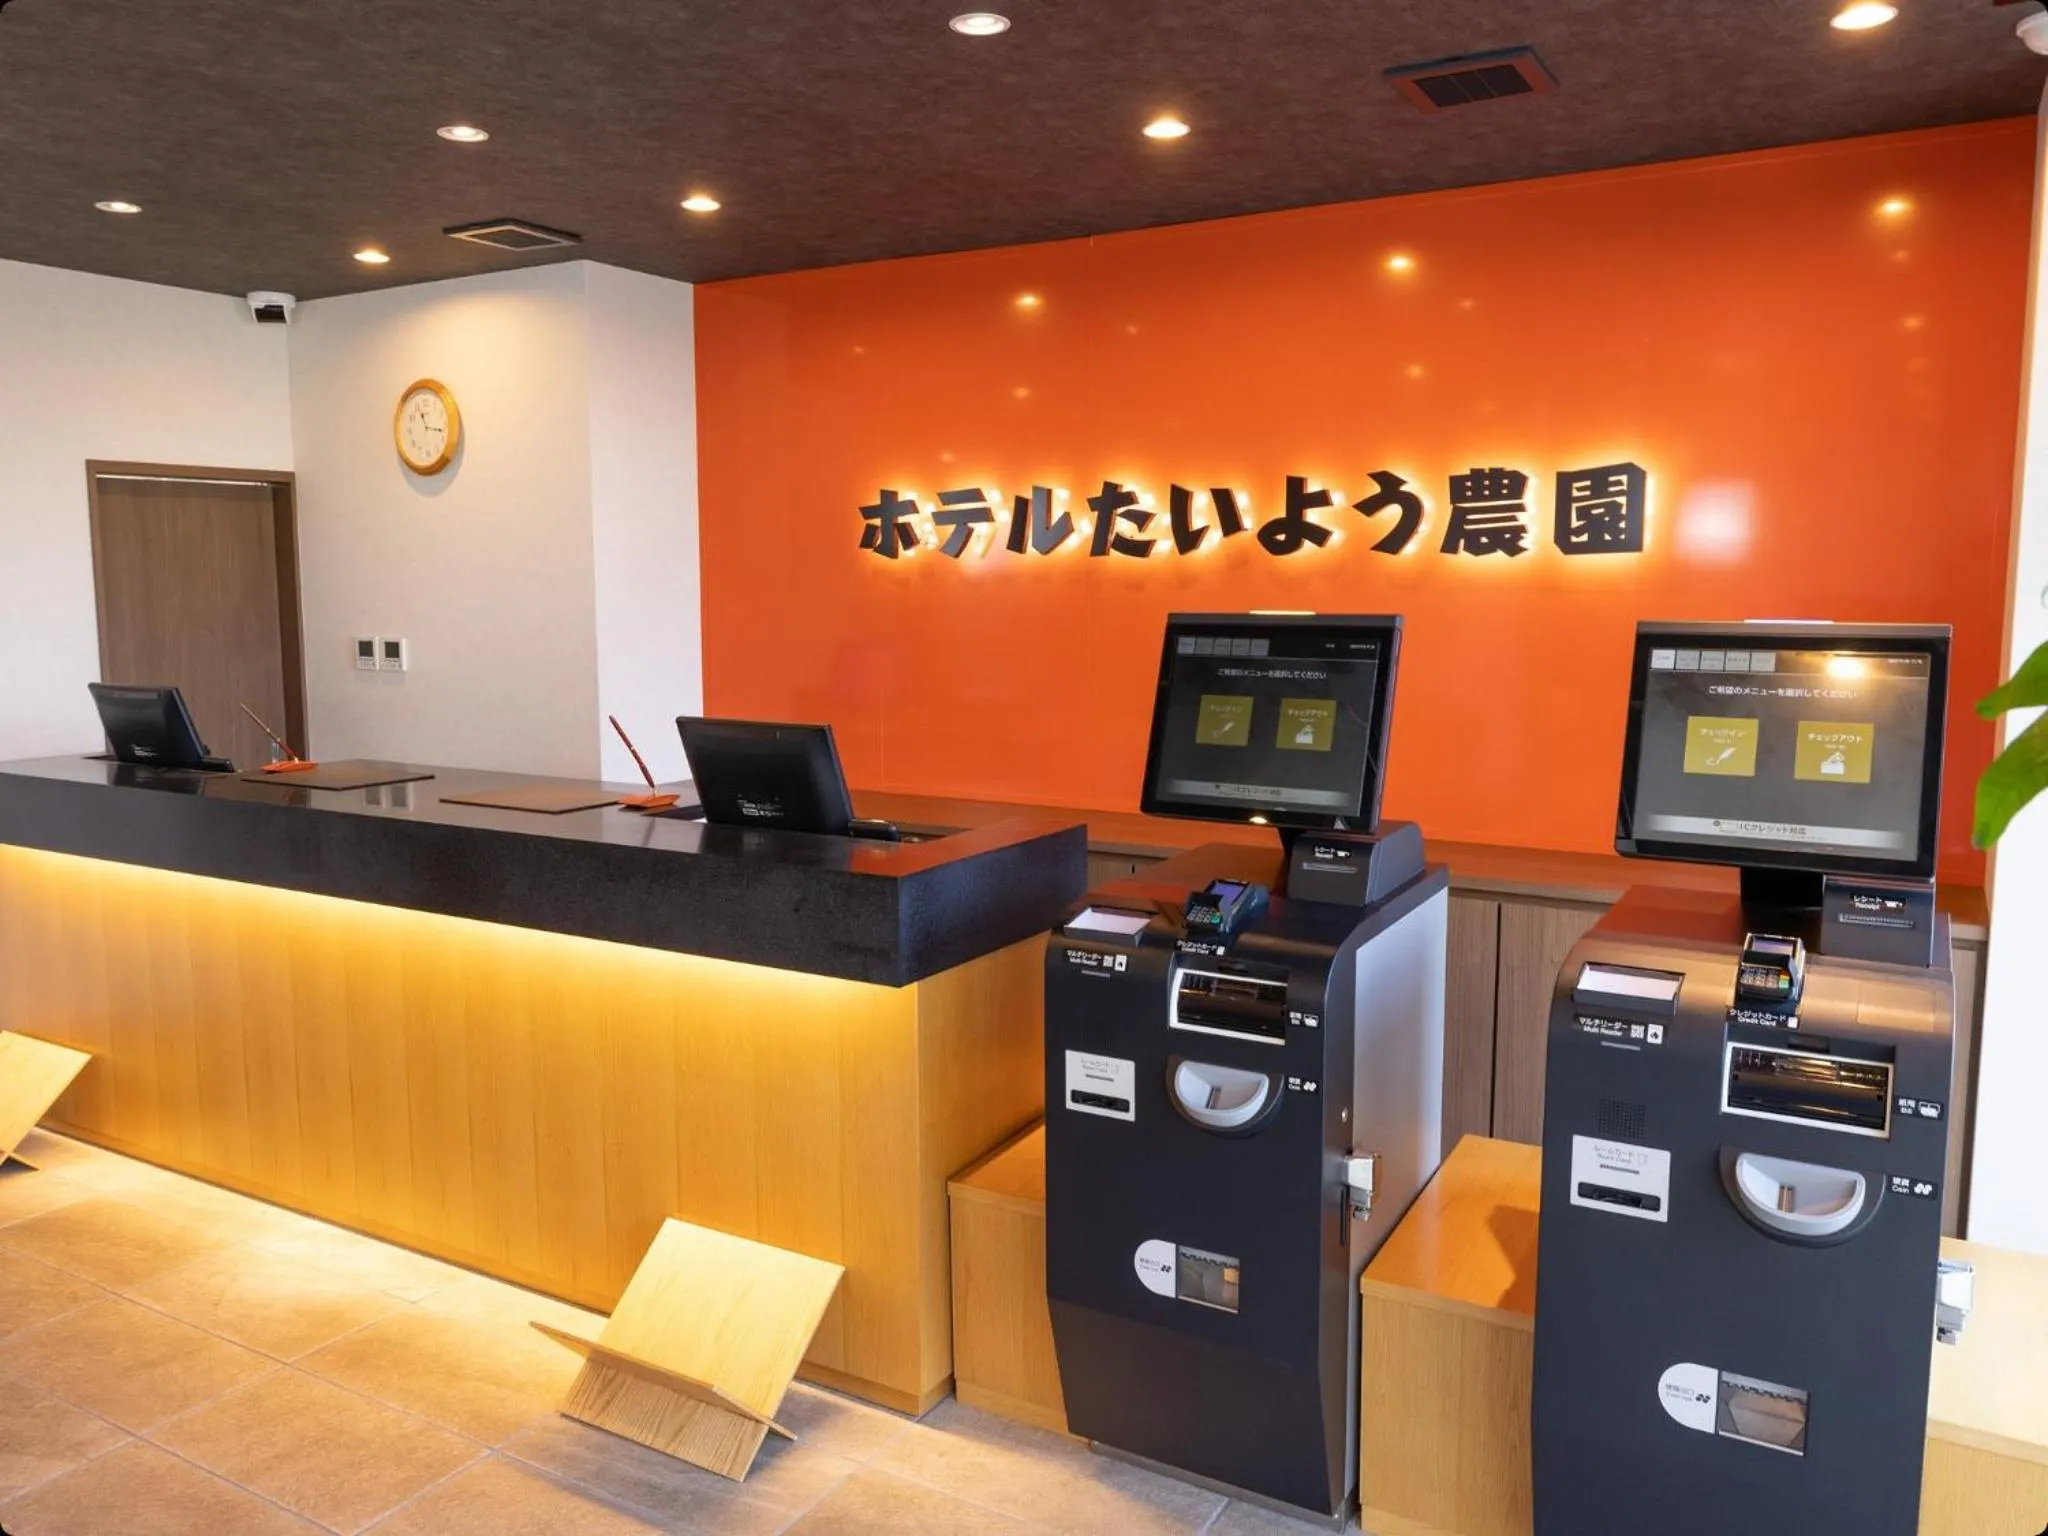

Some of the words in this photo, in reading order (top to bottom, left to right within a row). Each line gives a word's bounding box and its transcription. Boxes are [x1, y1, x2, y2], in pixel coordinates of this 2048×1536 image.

[858, 462, 1647, 559] ホテルたいよう農園
[1730, 1008, 1787, 1022] クレジットカード
[1579, 1016, 1628, 1029] マルチリーダー
